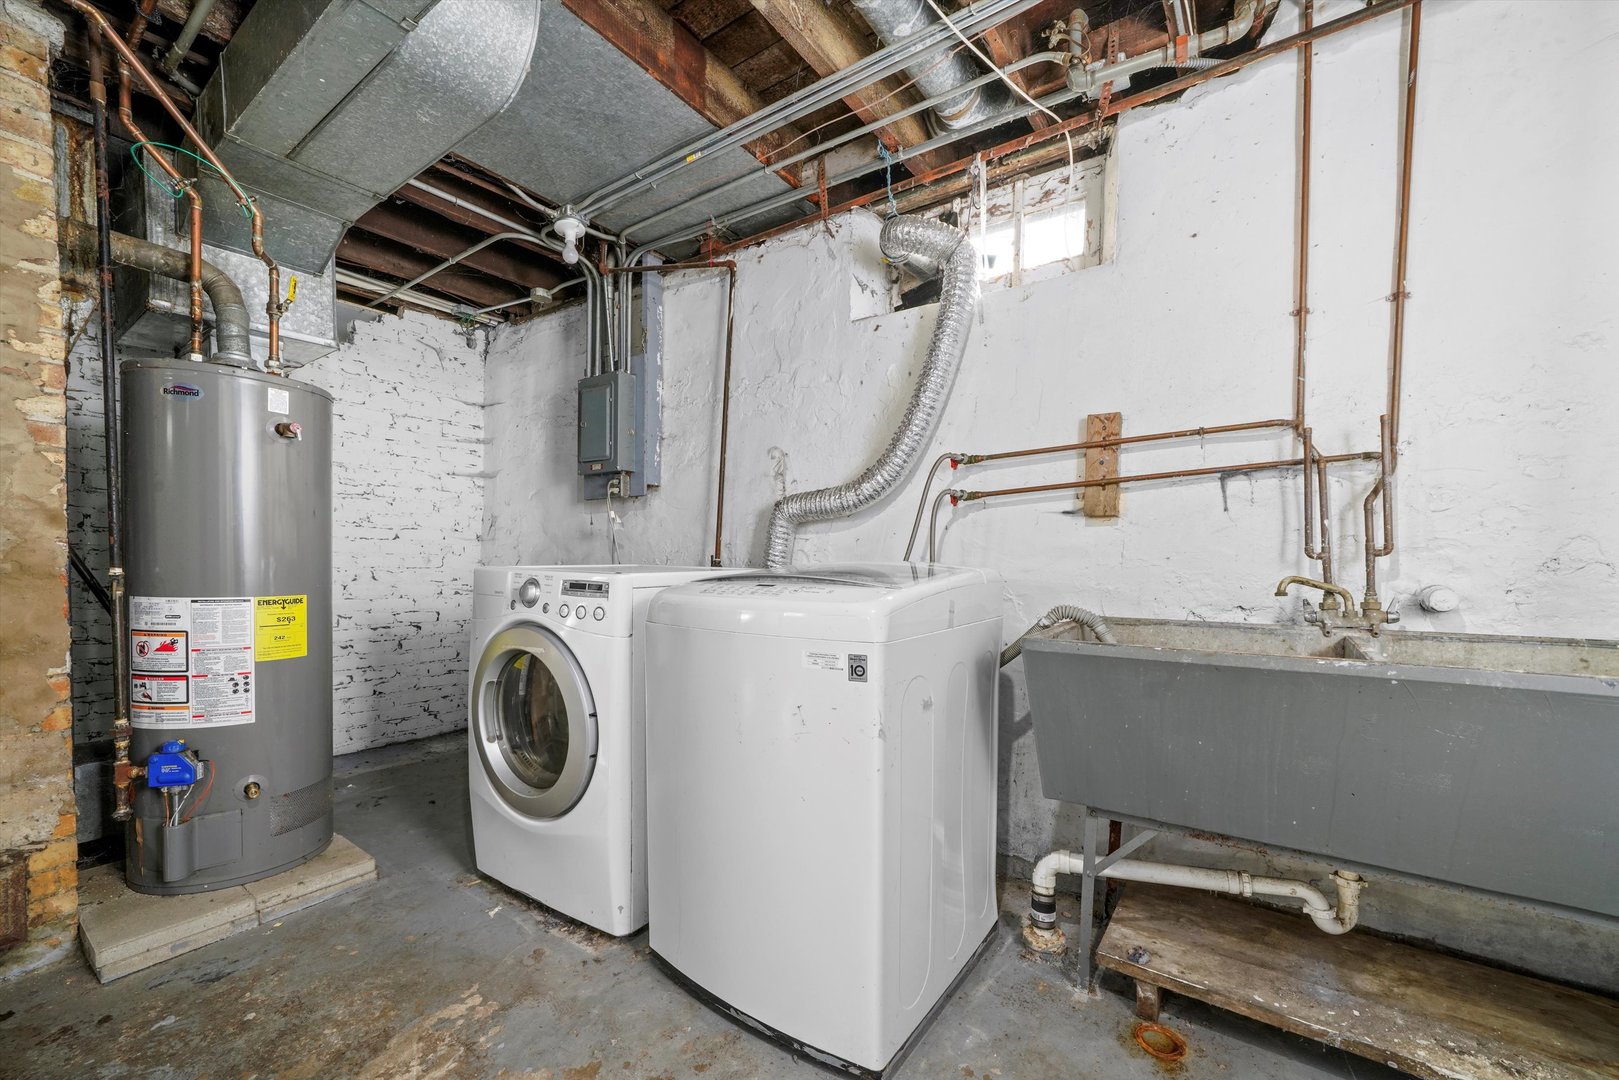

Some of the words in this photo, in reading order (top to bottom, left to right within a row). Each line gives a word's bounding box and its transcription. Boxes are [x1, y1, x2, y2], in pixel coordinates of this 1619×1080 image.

[163, 387, 200, 397] Richmond
[257, 598, 304, 607] ENERGYGUIDE
[850, 664, 866, 678] 10
